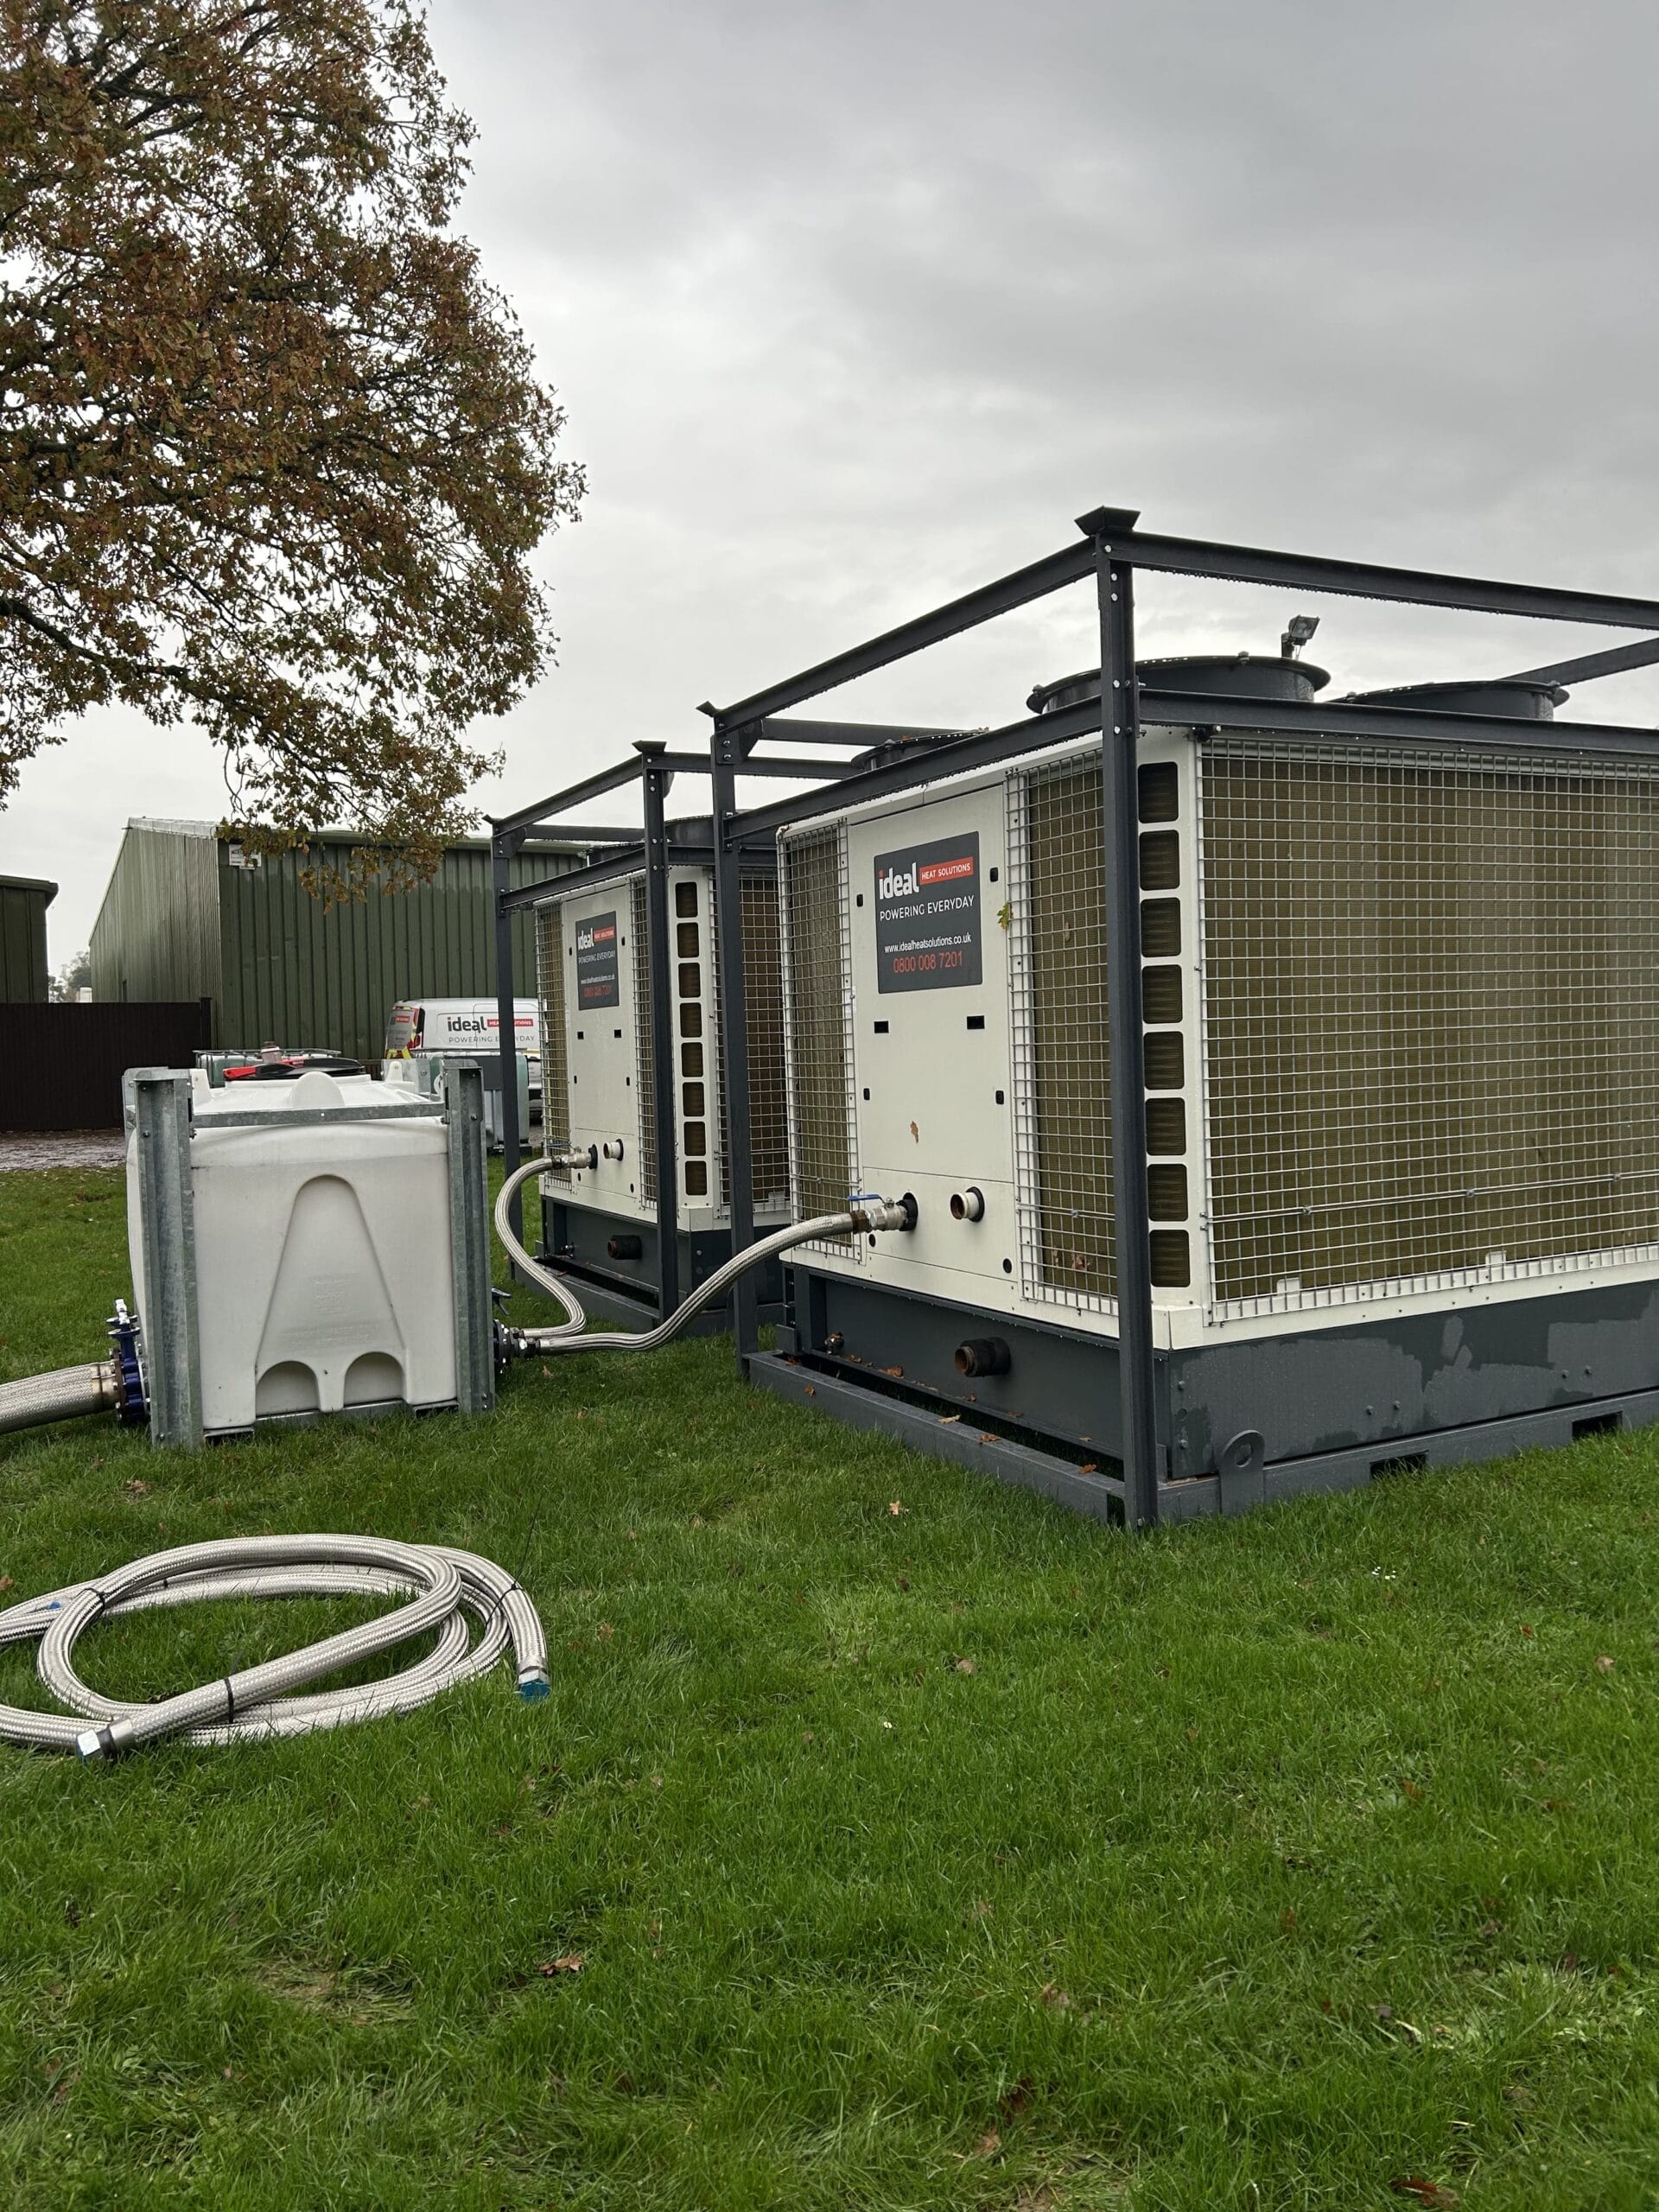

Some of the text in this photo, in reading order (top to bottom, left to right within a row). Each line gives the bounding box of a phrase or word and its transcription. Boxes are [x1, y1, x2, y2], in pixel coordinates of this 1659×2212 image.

[879, 862, 919, 899] ideal
[921, 863, 970, 880] HEAT SOLUTIONS
[880, 895, 975, 921] POWERING EVERYDAY
[578, 927, 594, 950] ideal
[884, 931, 972, 954] www.idealheatsolutions.co.uk
[893, 950, 963, 973] 0800 008 7201
[448, 1016, 486, 1032] ideal
